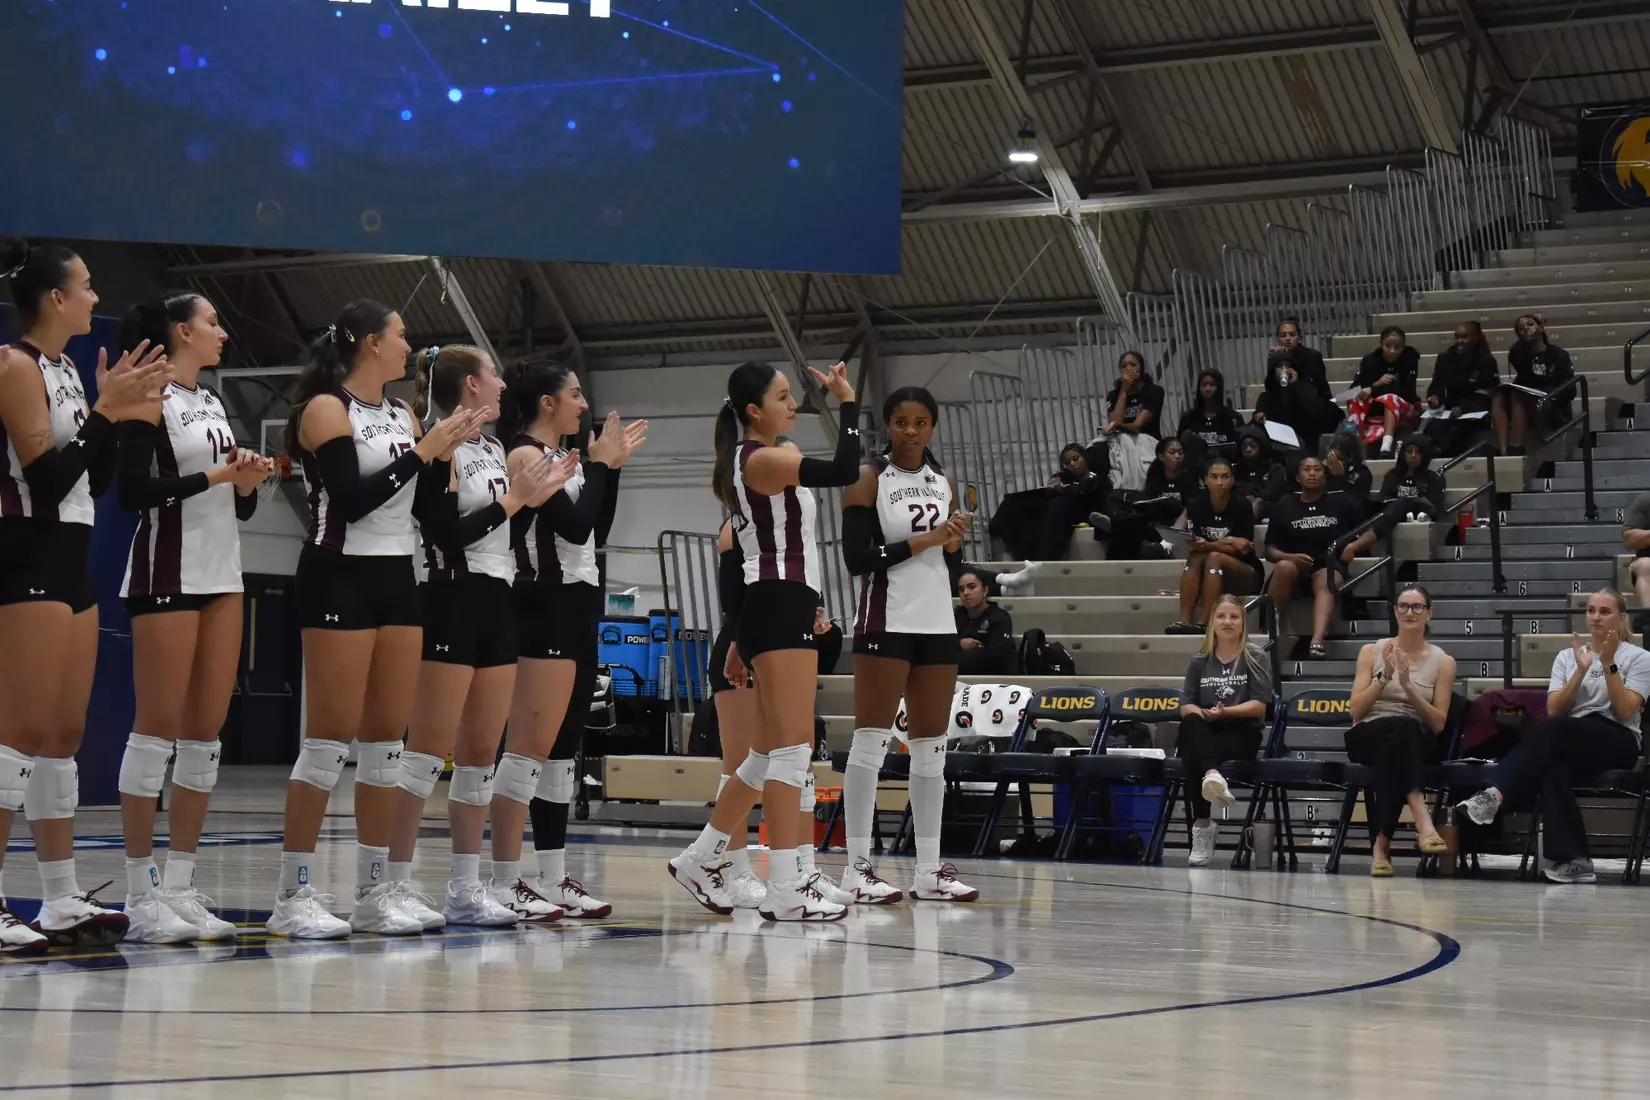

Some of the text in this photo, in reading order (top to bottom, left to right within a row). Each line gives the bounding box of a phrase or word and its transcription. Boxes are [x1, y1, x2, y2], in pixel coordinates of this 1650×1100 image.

[207, 428, 234, 464] 14
[488, 477, 507, 503] 17
[908, 503, 940, 533] 22
[1499, 511, 1505, 525] A
[1616, 509, 1622, 522] 8
[1455, 547, 1461, 560] A
[1567, 545, 1573, 558] 7
[1519, 583, 1525, 596] 6
[1350, 621, 1356, 635] A
[1465, 621, 1472, 635] 5
[1531, 621, 1537, 634] B
[627, 635, 650, 645] POWE
[1295, 662, 1302, 676] A
[1481, 663, 1488, 677] B
[1040, 696, 1096, 710] LIONS
[1122, 696, 1180, 711] LIONS
[1307, 805, 1314, 820] B
